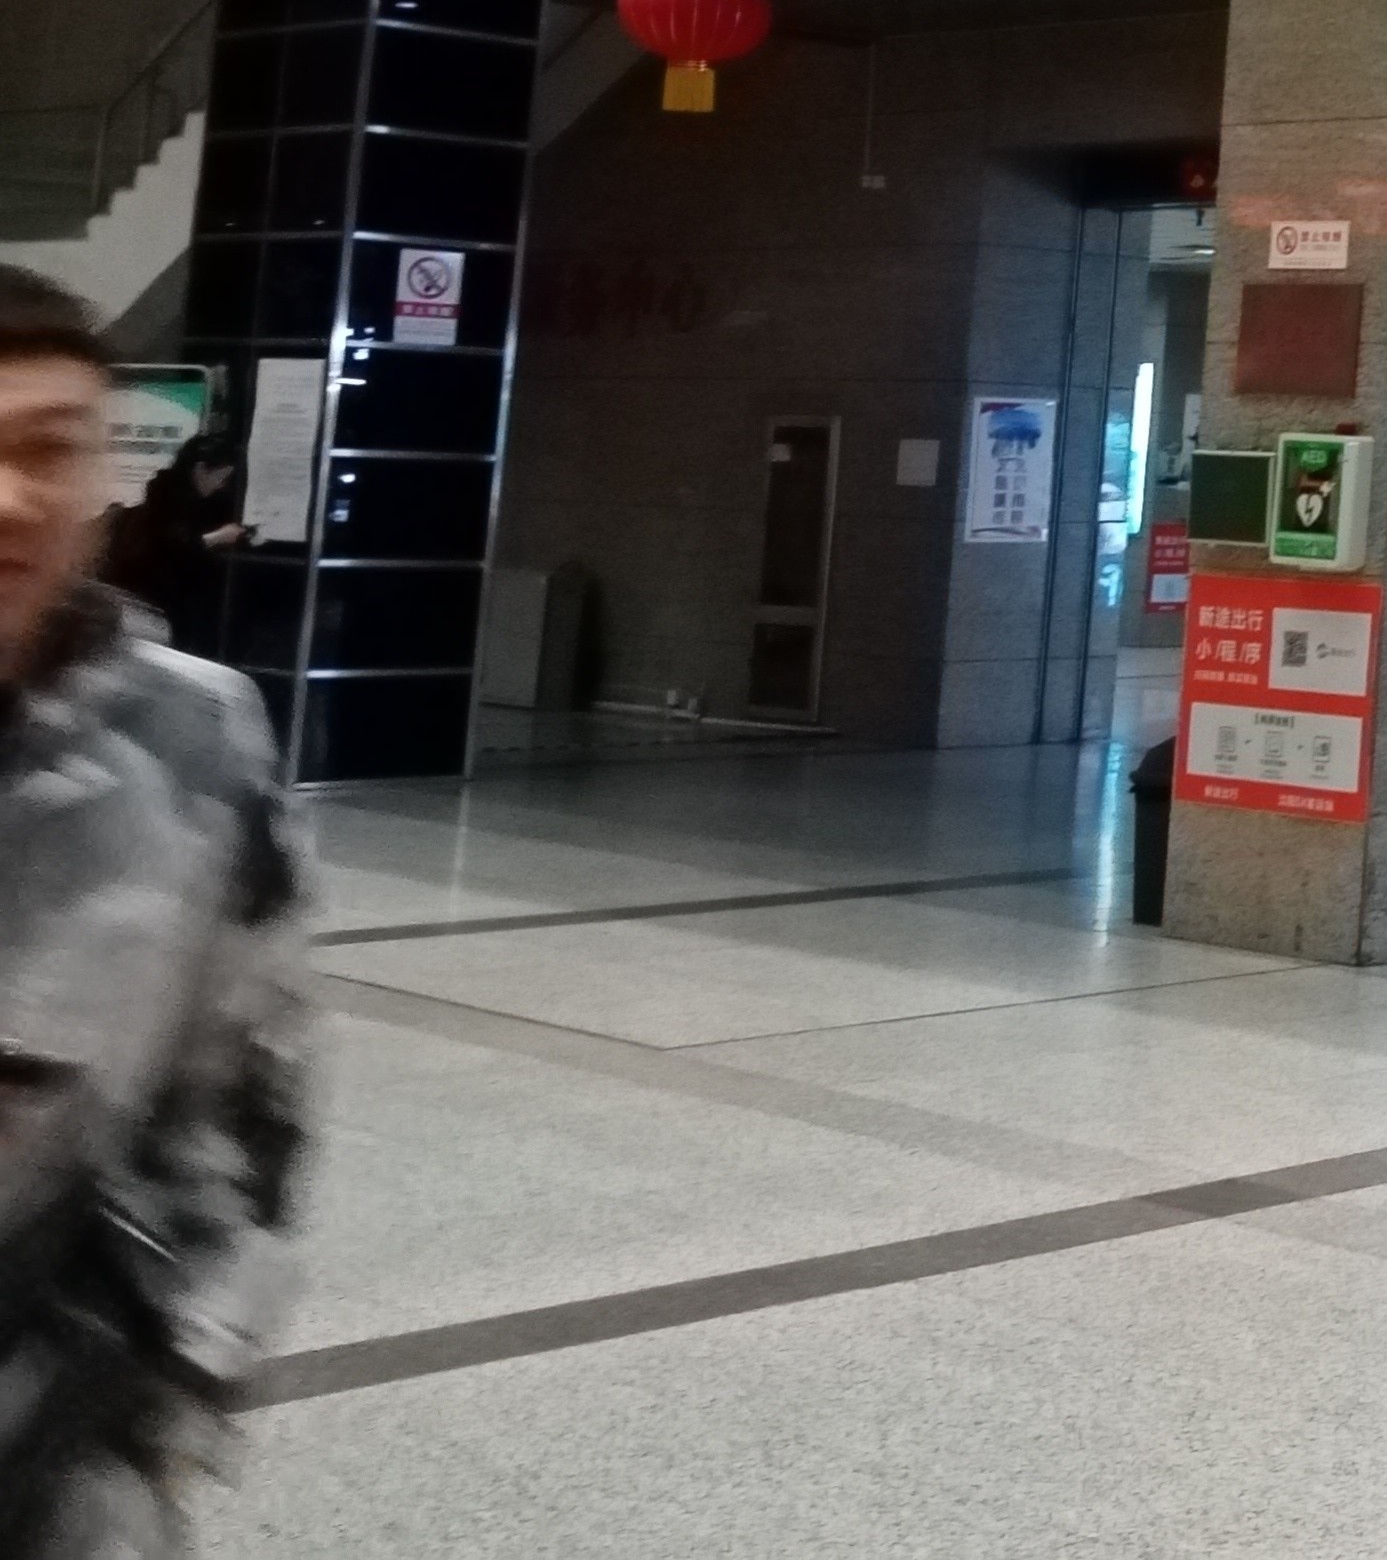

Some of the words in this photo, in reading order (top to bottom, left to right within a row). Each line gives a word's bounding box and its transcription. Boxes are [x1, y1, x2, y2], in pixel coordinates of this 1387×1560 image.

[1301, 449, 1327, 464] AED
[1195, 636, 1263, 665] 小程序
